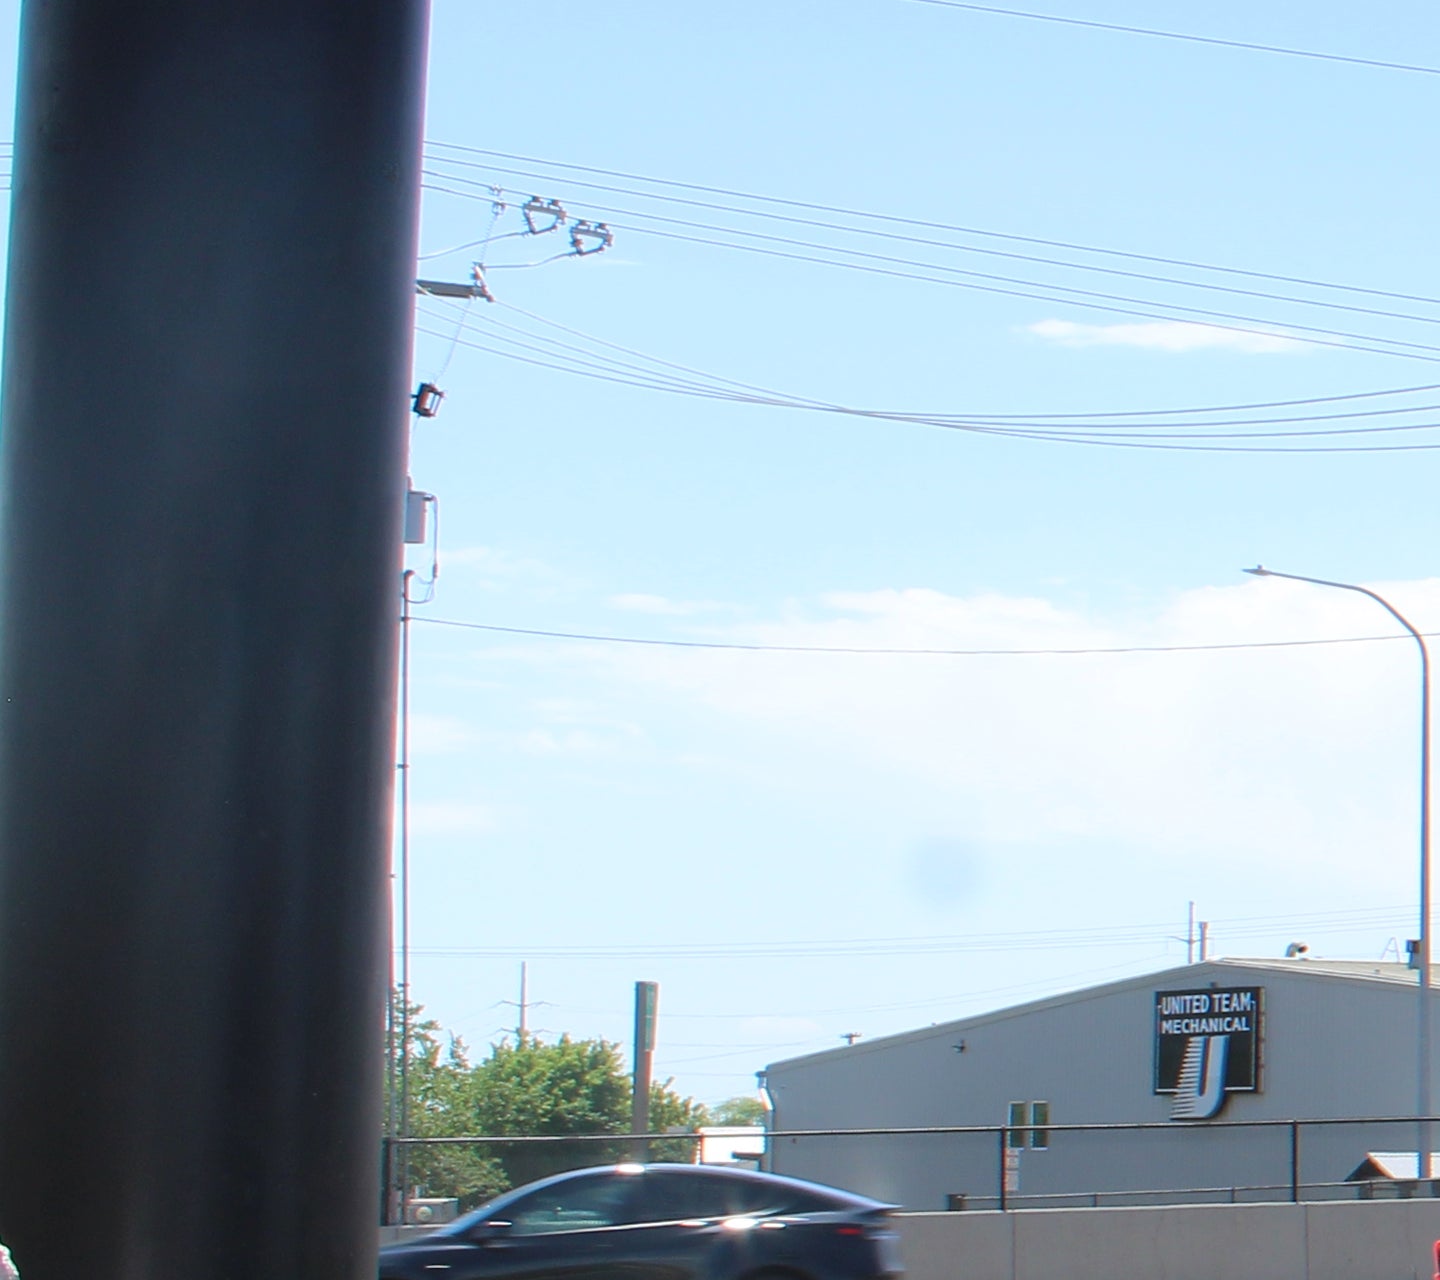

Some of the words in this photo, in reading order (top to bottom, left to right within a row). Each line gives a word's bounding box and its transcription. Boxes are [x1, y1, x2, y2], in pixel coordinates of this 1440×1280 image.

[1161, 994, 1210, 1014] UNITED
[1212, 992, 1251, 1013] TEAM
[1161, 1016, 1250, 1034] MECHANICAL
